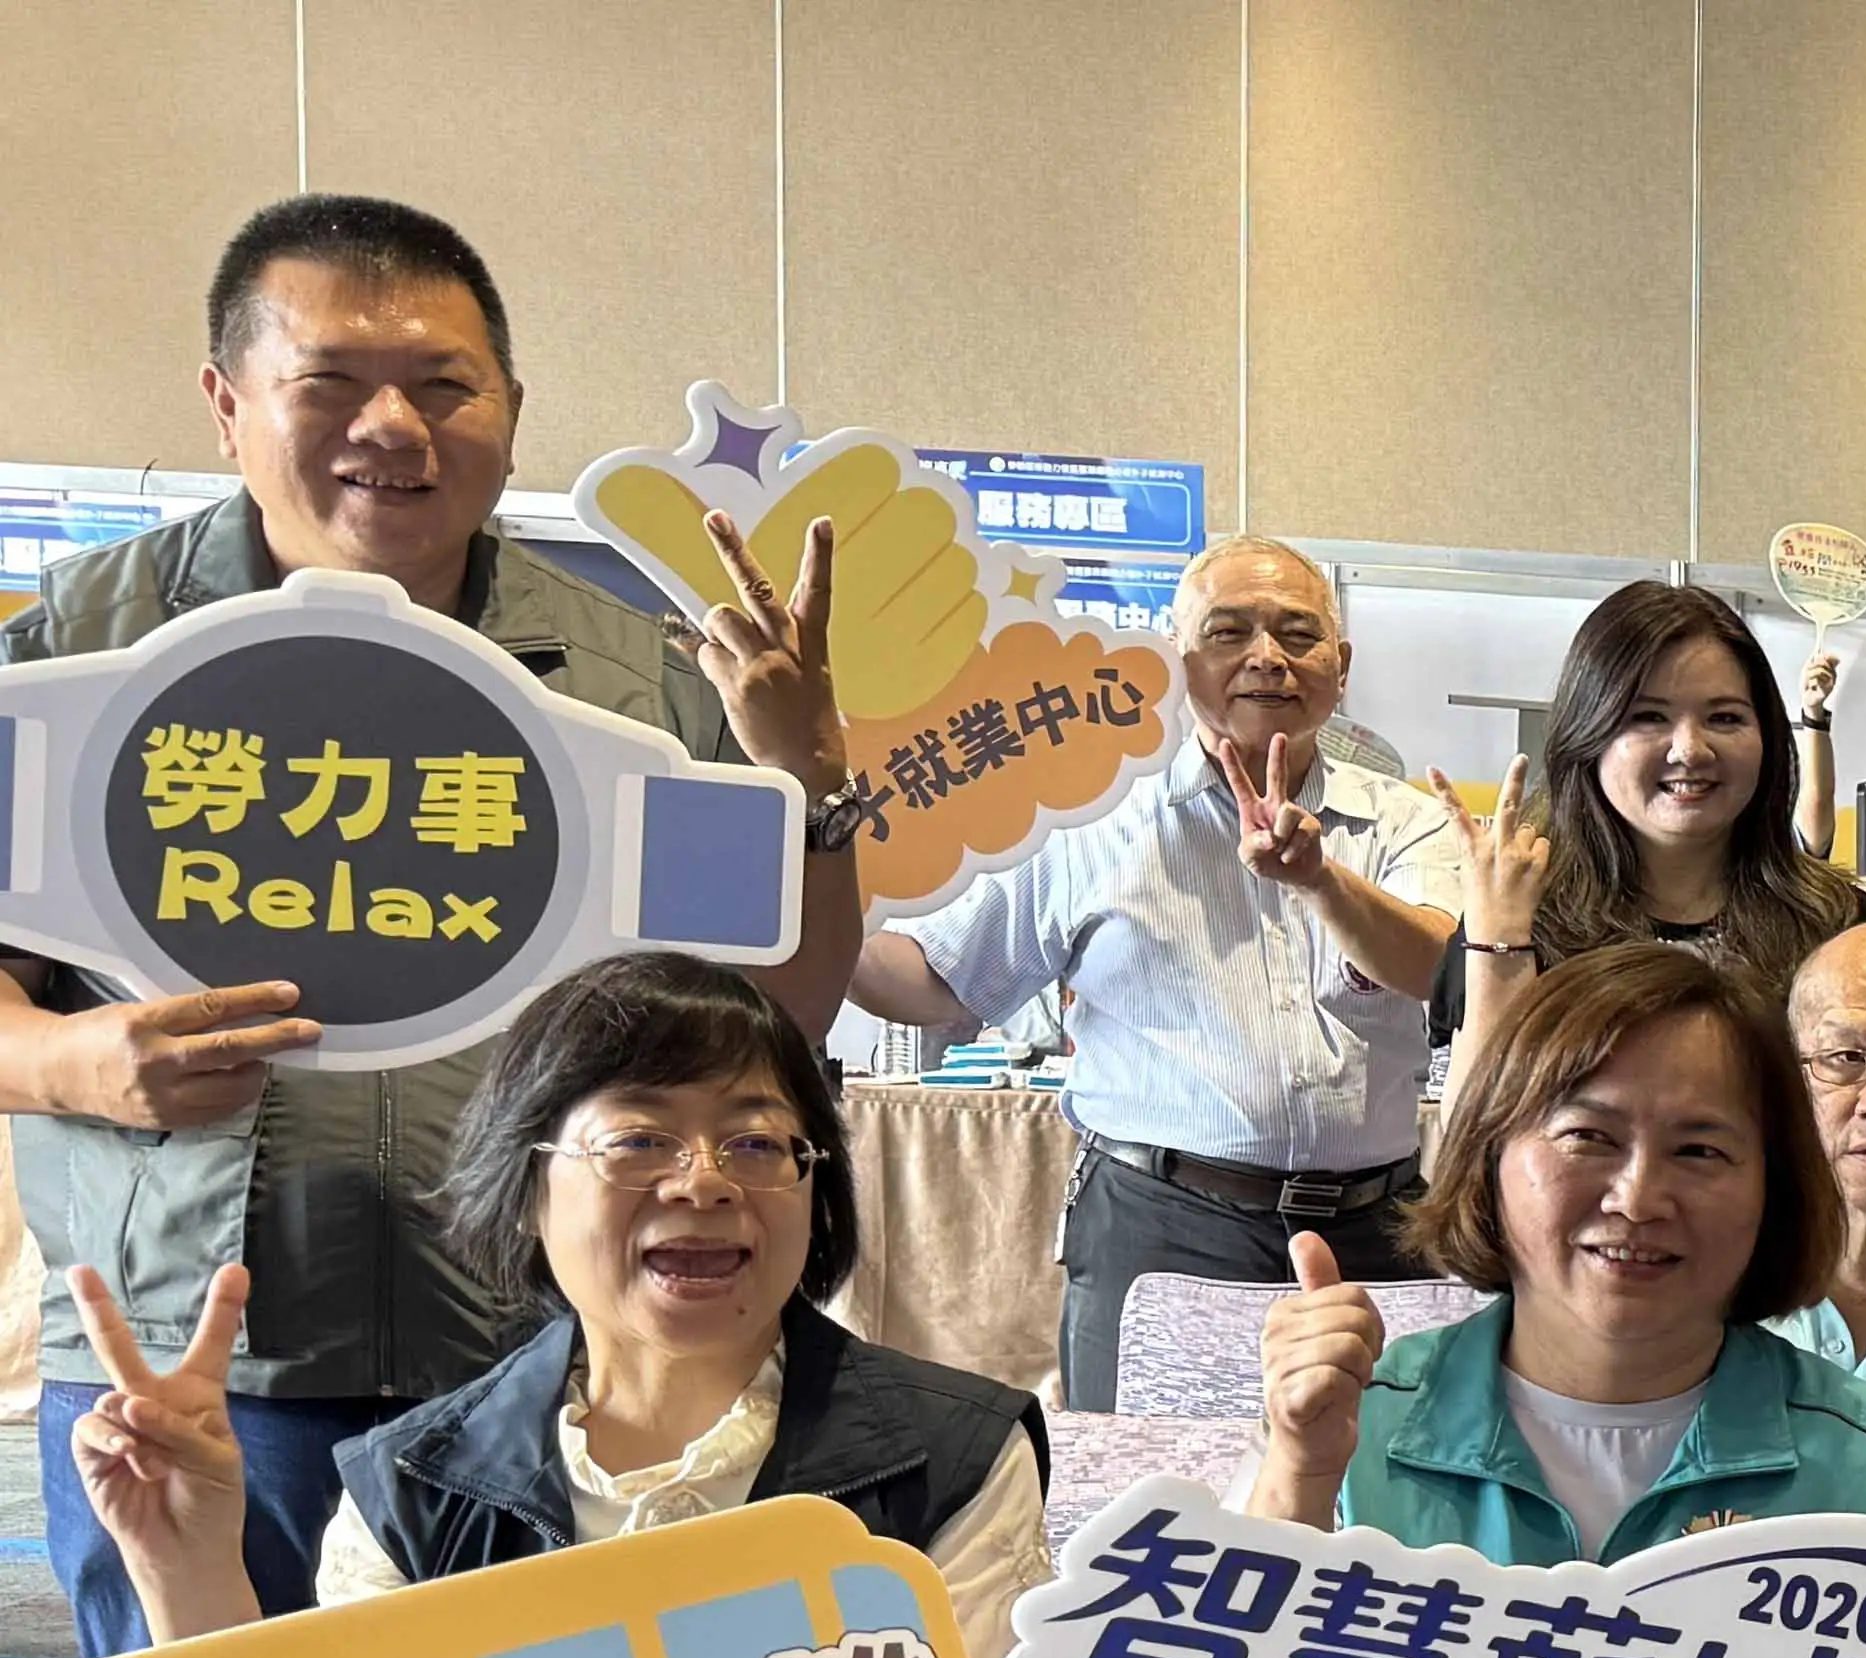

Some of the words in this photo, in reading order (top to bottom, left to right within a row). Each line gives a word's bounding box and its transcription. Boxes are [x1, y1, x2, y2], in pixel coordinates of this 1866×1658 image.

[140, 722, 528, 854] 勞力事
[156, 846, 503, 944] Relax
